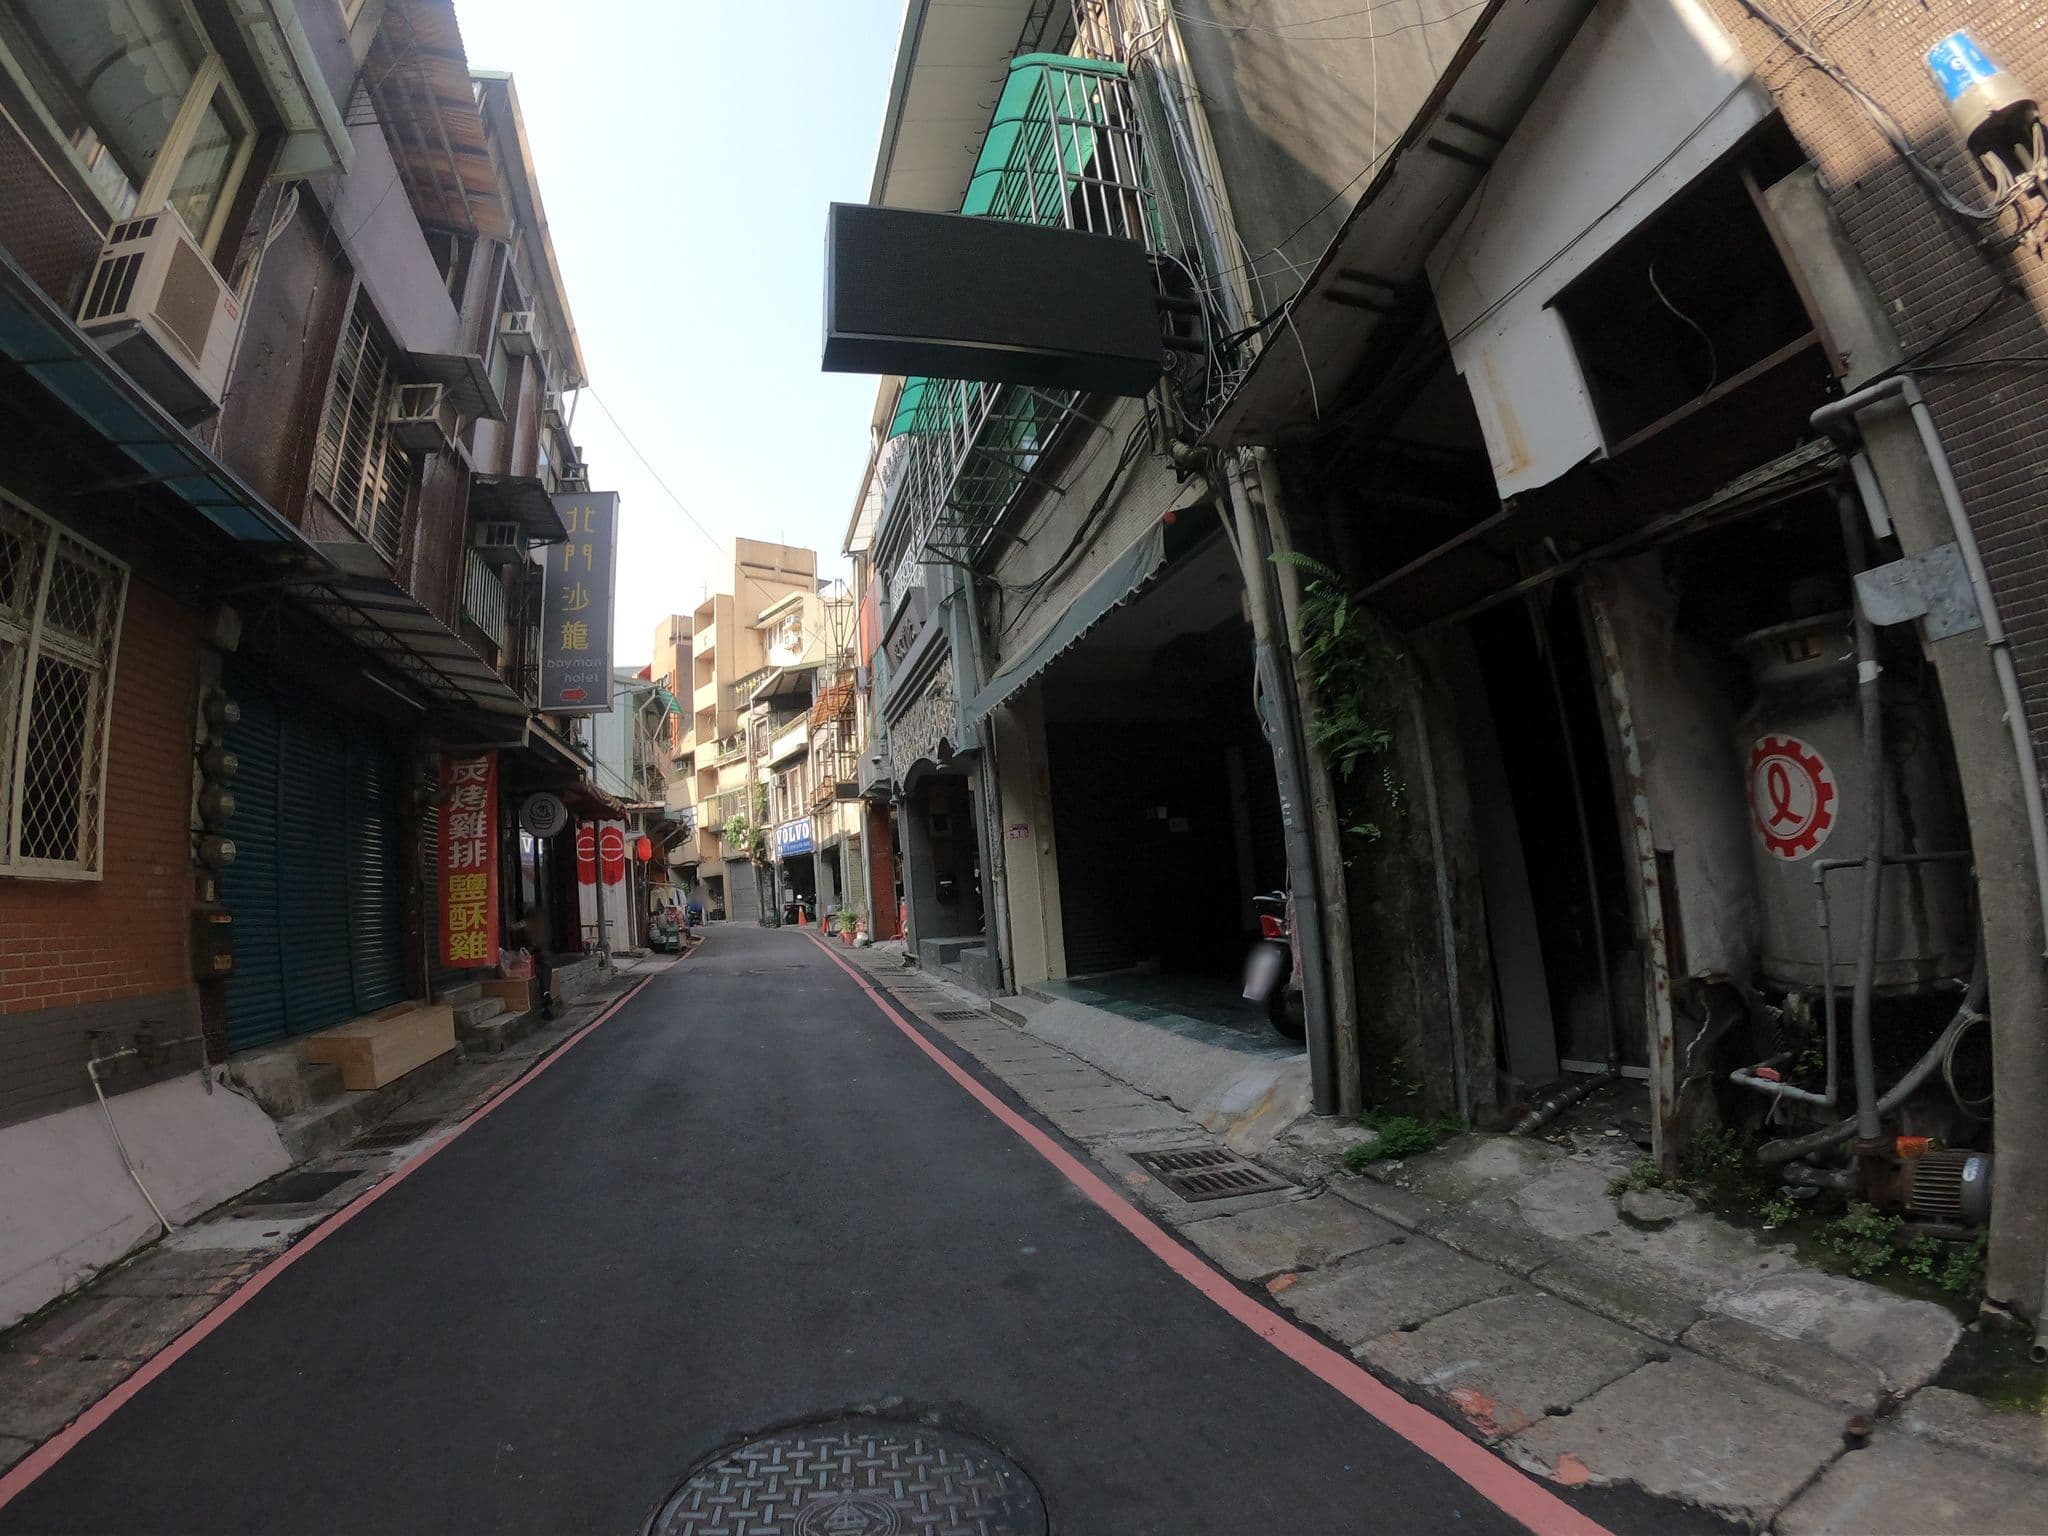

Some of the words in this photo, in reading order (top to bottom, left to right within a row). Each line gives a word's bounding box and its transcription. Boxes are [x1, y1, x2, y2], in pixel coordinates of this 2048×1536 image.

[560, 505, 595, 651] 北門沙龍
[564, 672, 599, 683] hotel
[776, 822, 811, 845] VOLVO
